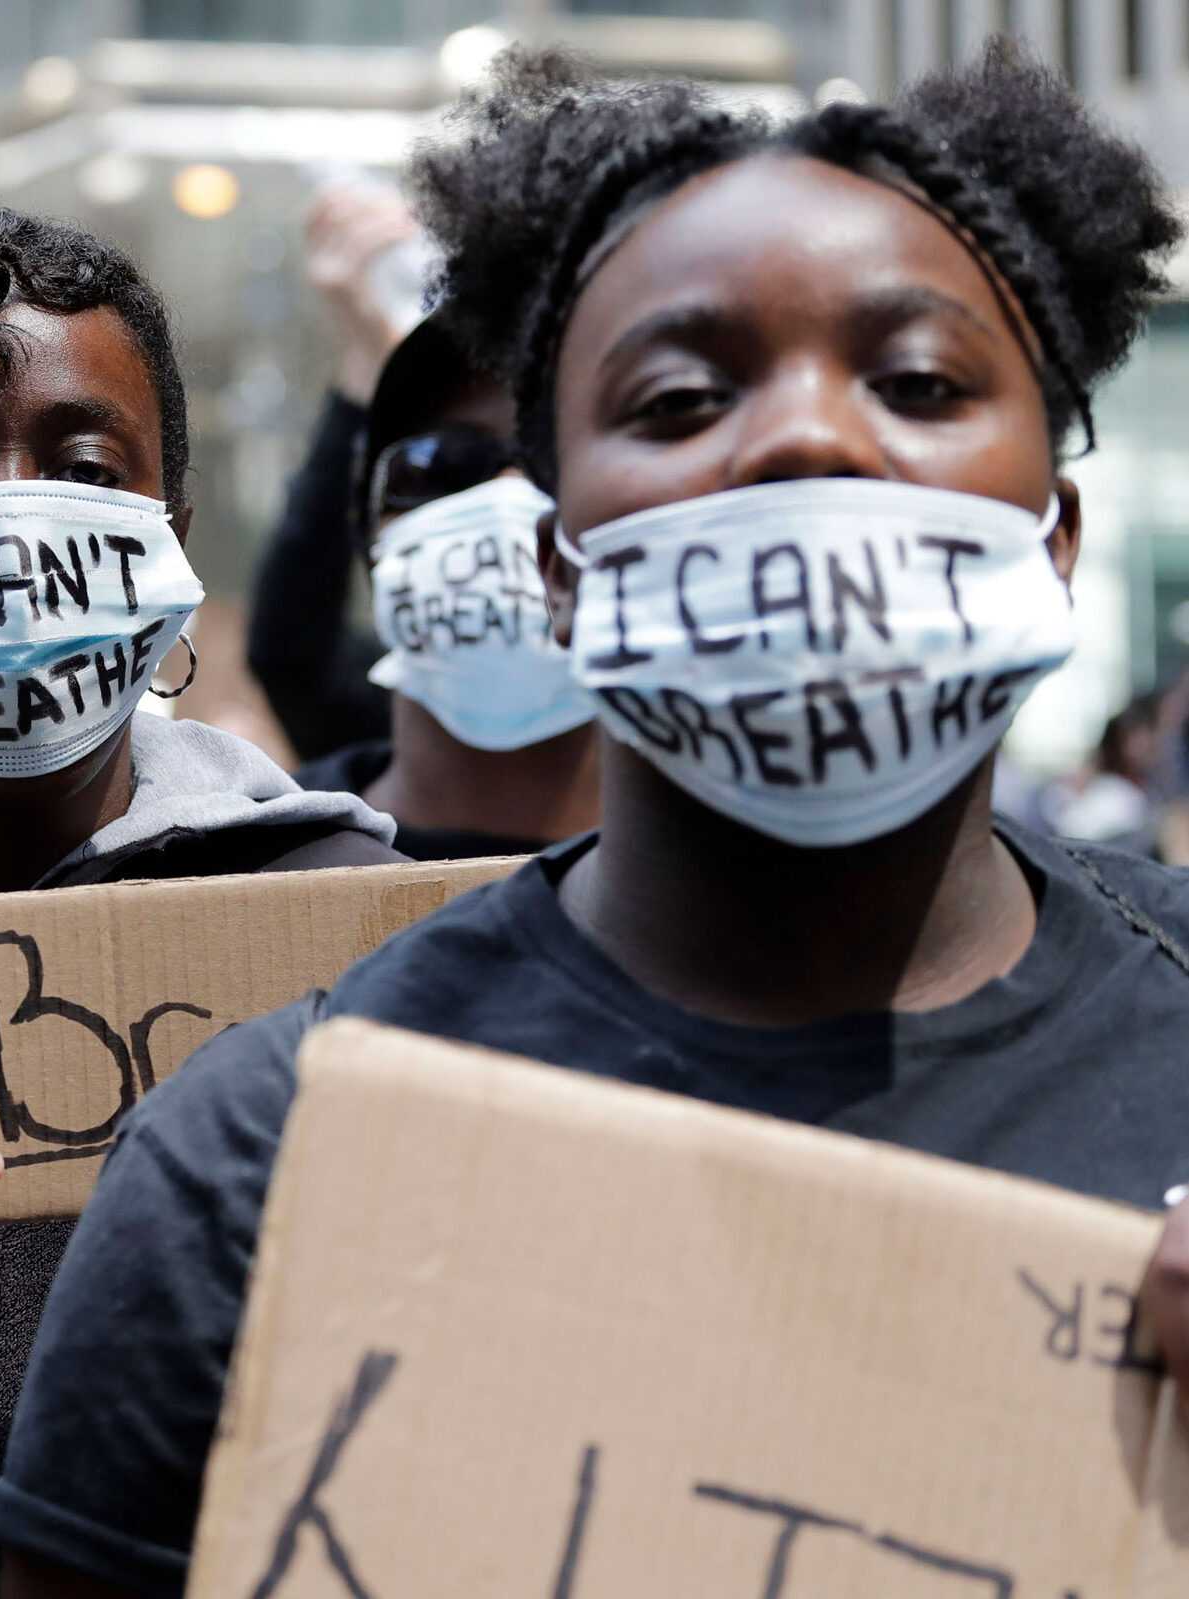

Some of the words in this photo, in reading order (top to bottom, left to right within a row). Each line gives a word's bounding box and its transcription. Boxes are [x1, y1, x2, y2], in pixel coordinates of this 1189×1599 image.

[388, 543, 421, 595] I
[587, 545, 653, 670] I
[676, 537, 984, 654] CAN'T
[390, 583, 553, 651] BREAT
[595, 665, 1041, 787] BREATHE
